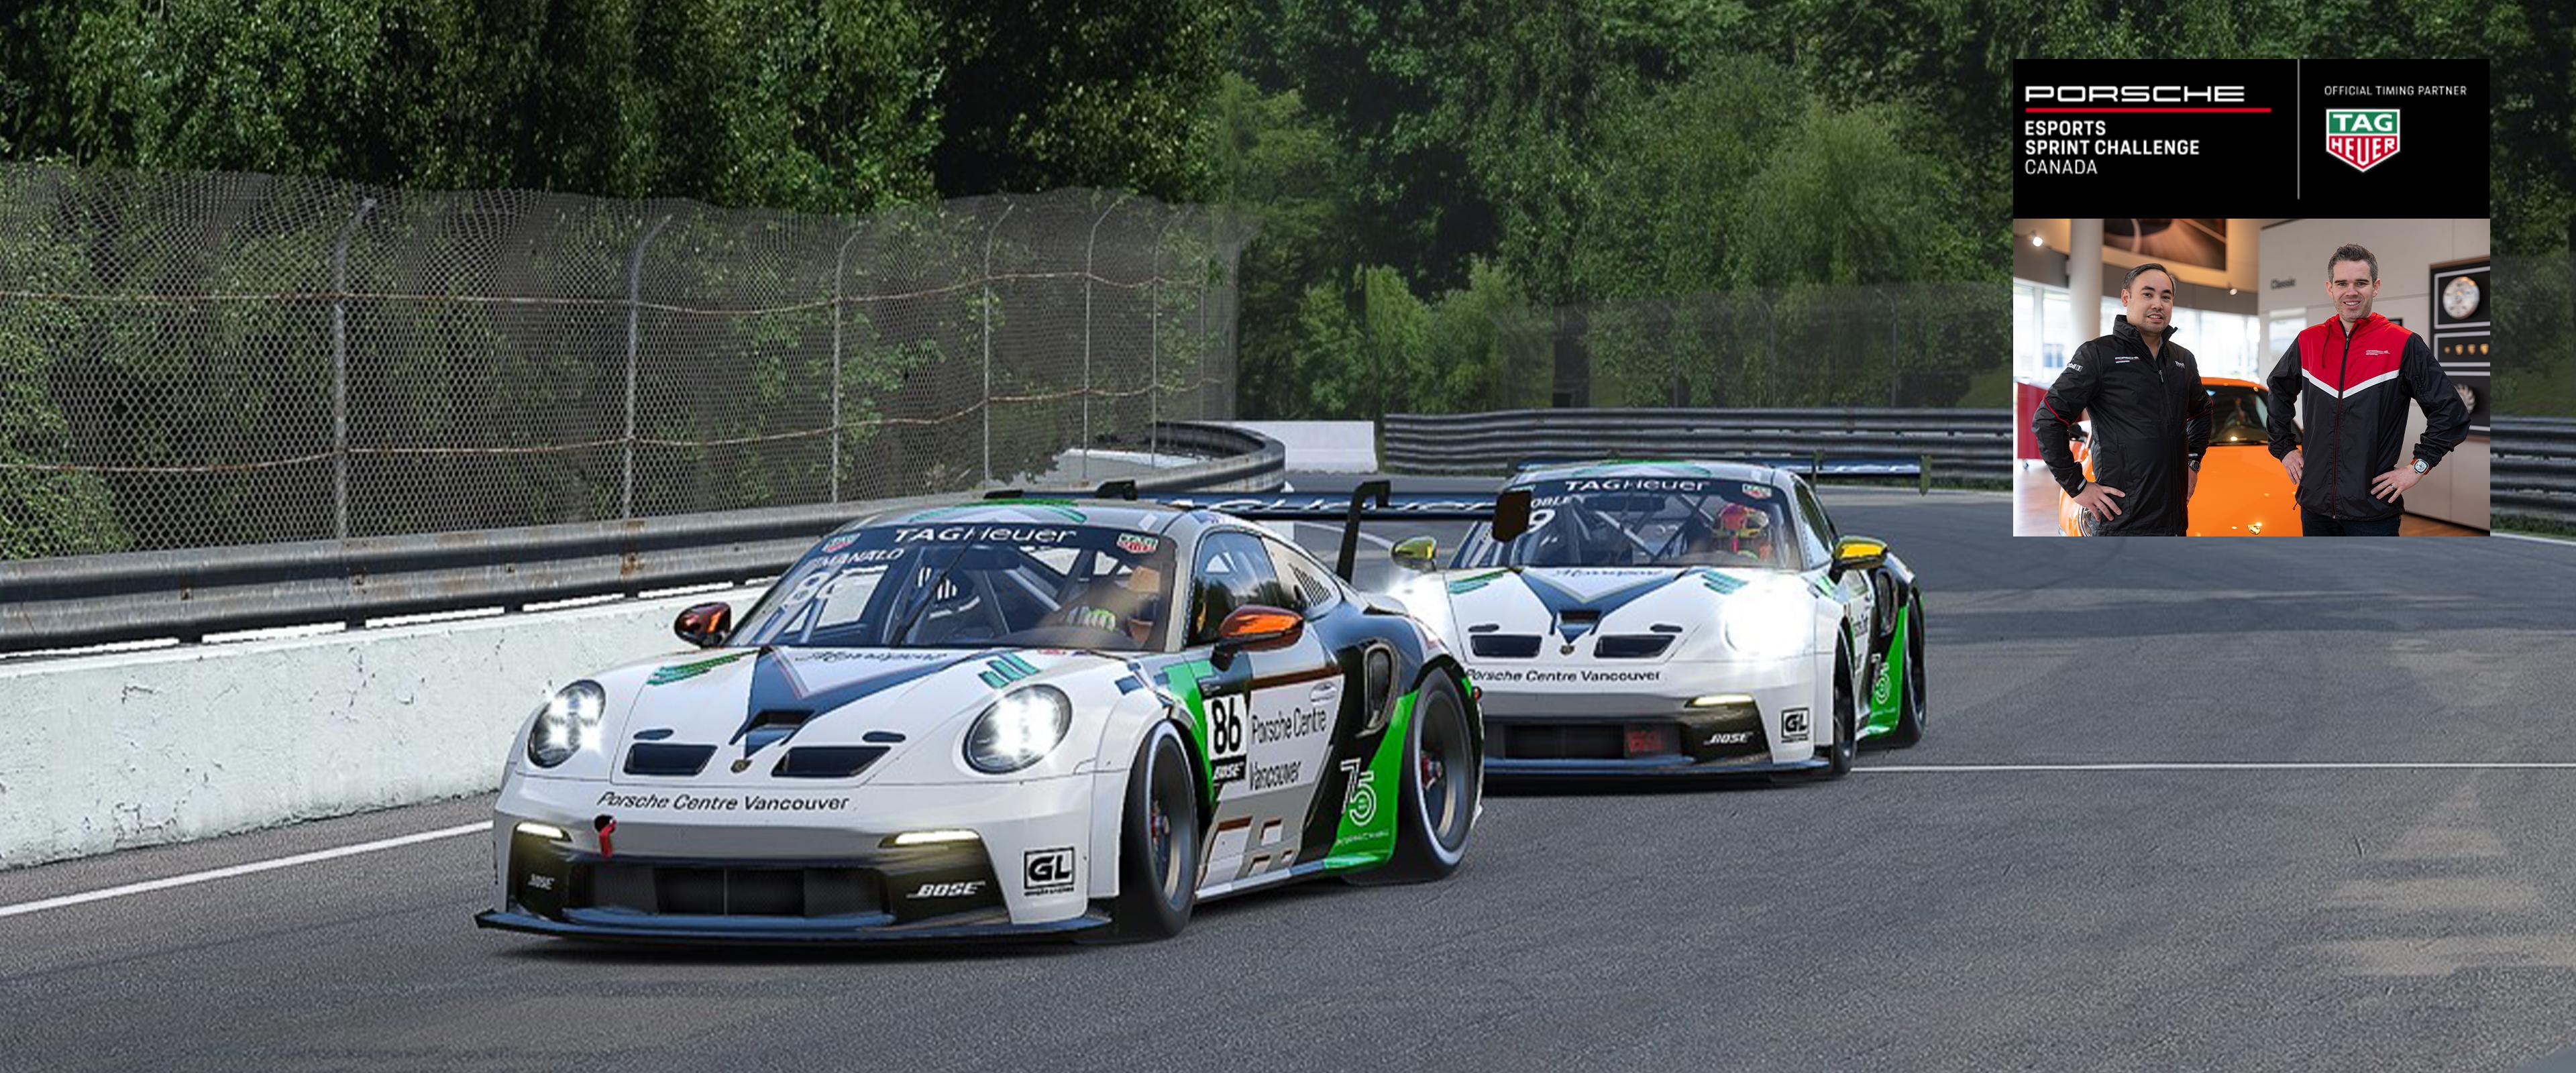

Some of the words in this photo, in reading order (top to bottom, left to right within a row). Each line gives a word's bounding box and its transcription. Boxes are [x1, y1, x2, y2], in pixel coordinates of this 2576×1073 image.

[2270, 278, 2296, 290] Classic
[1465, 669, 1523, 681] Porsche
[1525, 671, 1577, 681] Centre
[1580, 670, 1661, 681] Vancouver
[1212, 697, 1242, 755] 86
[1251, 711, 1292, 744] Porsche
[1293, 708, 1326, 737] Centre
[1785, 714, 1808, 733] GL
[1249, 761, 1301, 790] Vancouver
[596, 791, 669, 809] Porsche
[673, 794, 739, 810] Centre
[744, 795, 850, 810] Vancouver
[1340, 757, 1377, 826] 75
[1028, 854, 1073, 882] GL
[906, 880, 986, 899] BOSE
